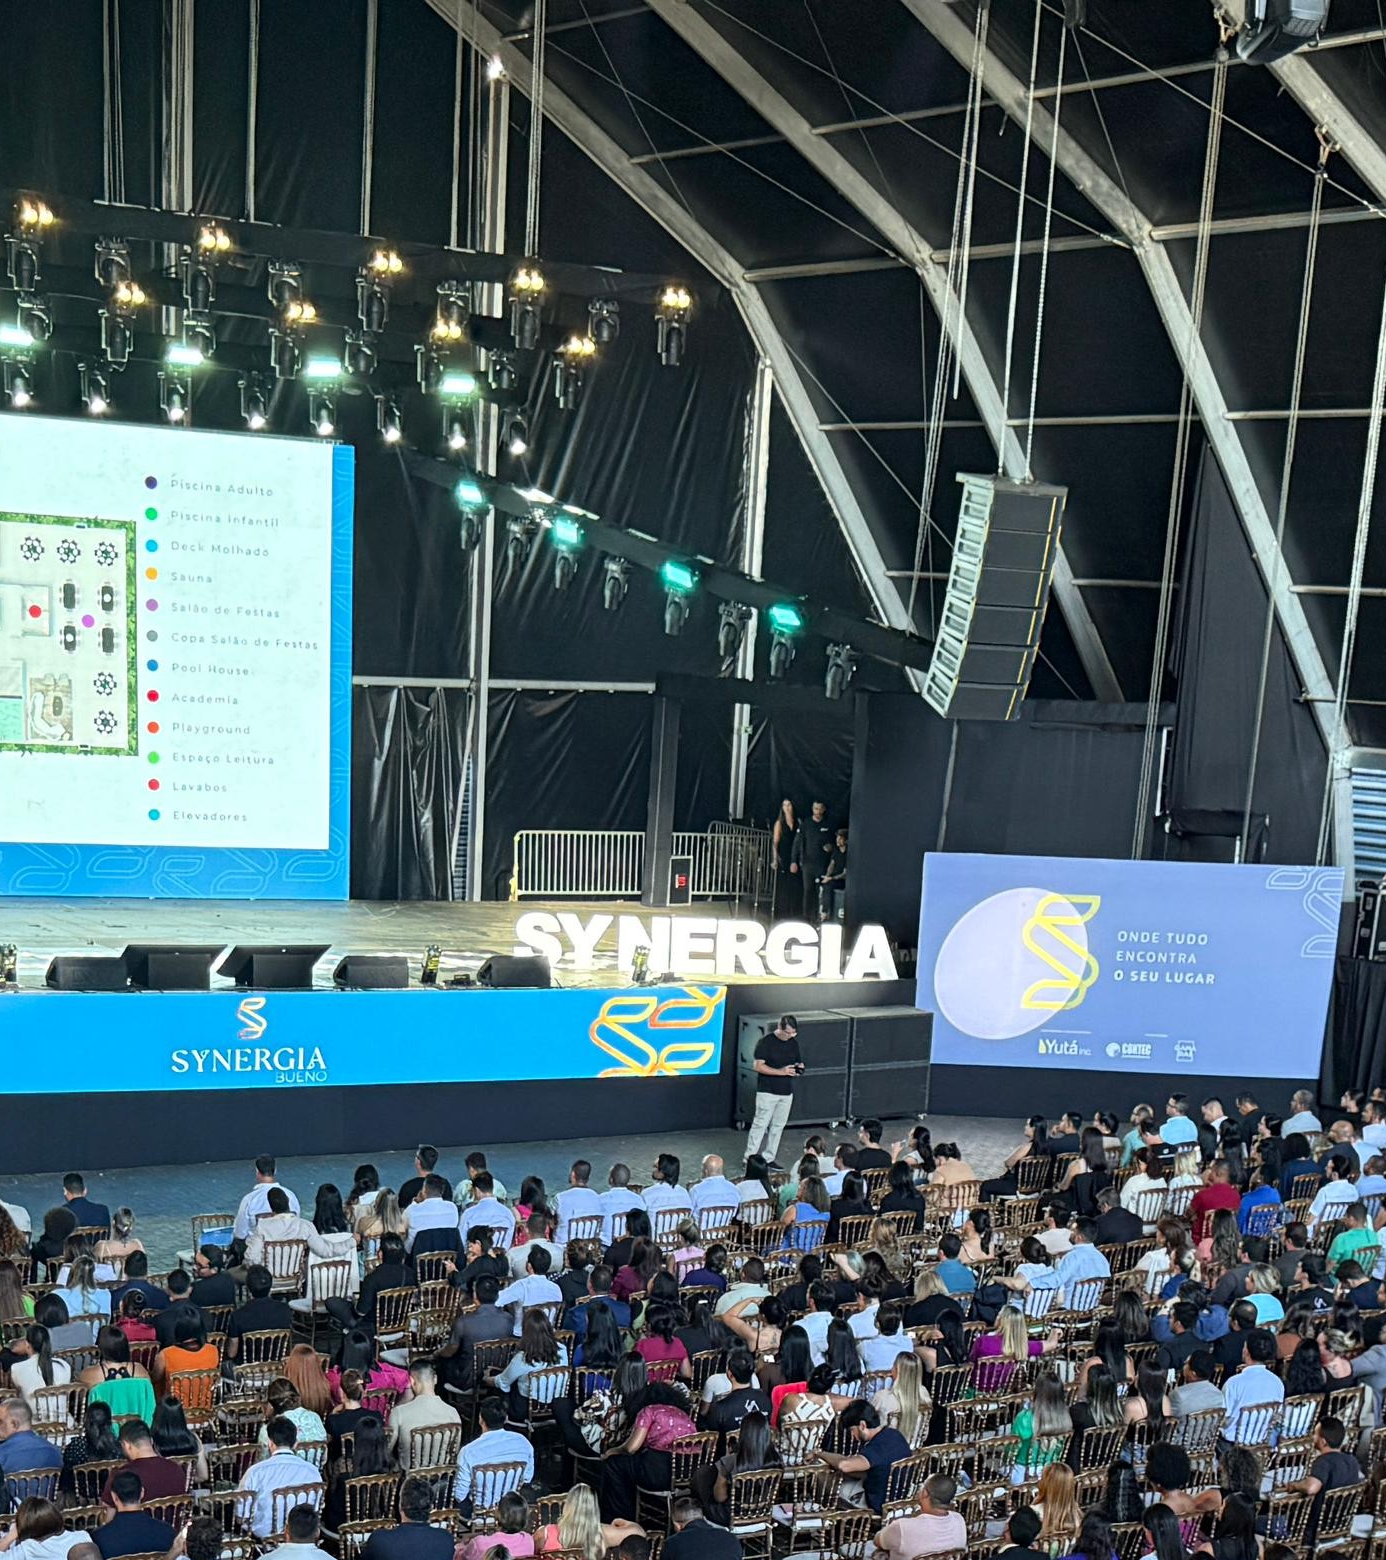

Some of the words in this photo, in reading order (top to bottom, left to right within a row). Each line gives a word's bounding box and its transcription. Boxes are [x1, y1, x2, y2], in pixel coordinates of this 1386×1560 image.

[171, 479, 221, 492] Piscina
[228, 484, 274, 497] Adulto
[171, 511, 221, 523] Piscina
[228, 514, 279, 528] Infantil
[171, 541, 205, 552] Deck
[211, 544, 269, 557] Molhado
[171, 572, 213, 583] Sauna
[171, 602, 208, 614] Salão
[215, 605, 230, 615] de
[237, 607, 280, 618] Festas
[171, 632, 205, 645] Copa
[254, 638, 269, 647] de
[276, 639, 318, 650] Festas
[172, 663, 202, 673] Pool
[208, 665, 249, 676] House
[172, 693, 238, 705] Academia
[172, 722, 251, 735] Playground
[173, 752, 220, 764] Espaço
[226, 754, 274, 765] Leitura
[173, 782, 227, 792] Lavabos
[173, 811, 247, 822] Elevadores
[1117, 931, 1160, 943] ONDE
[1167, 933, 1208, 945] TUDO
[514, 912, 899, 981] SYNERGIA
[1116, 951, 1196, 964] ENCONTRA
[1114, 970, 1124, 981] O
[1130, 971, 1159, 982] SEU
[1165, 972, 1215, 985] LUGAR
[1045, 1039, 1078, 1055] Yutá
[171, 1046, 326, 1073] SYNERGIA
[275, 1070, 327, 1083] BUENO
